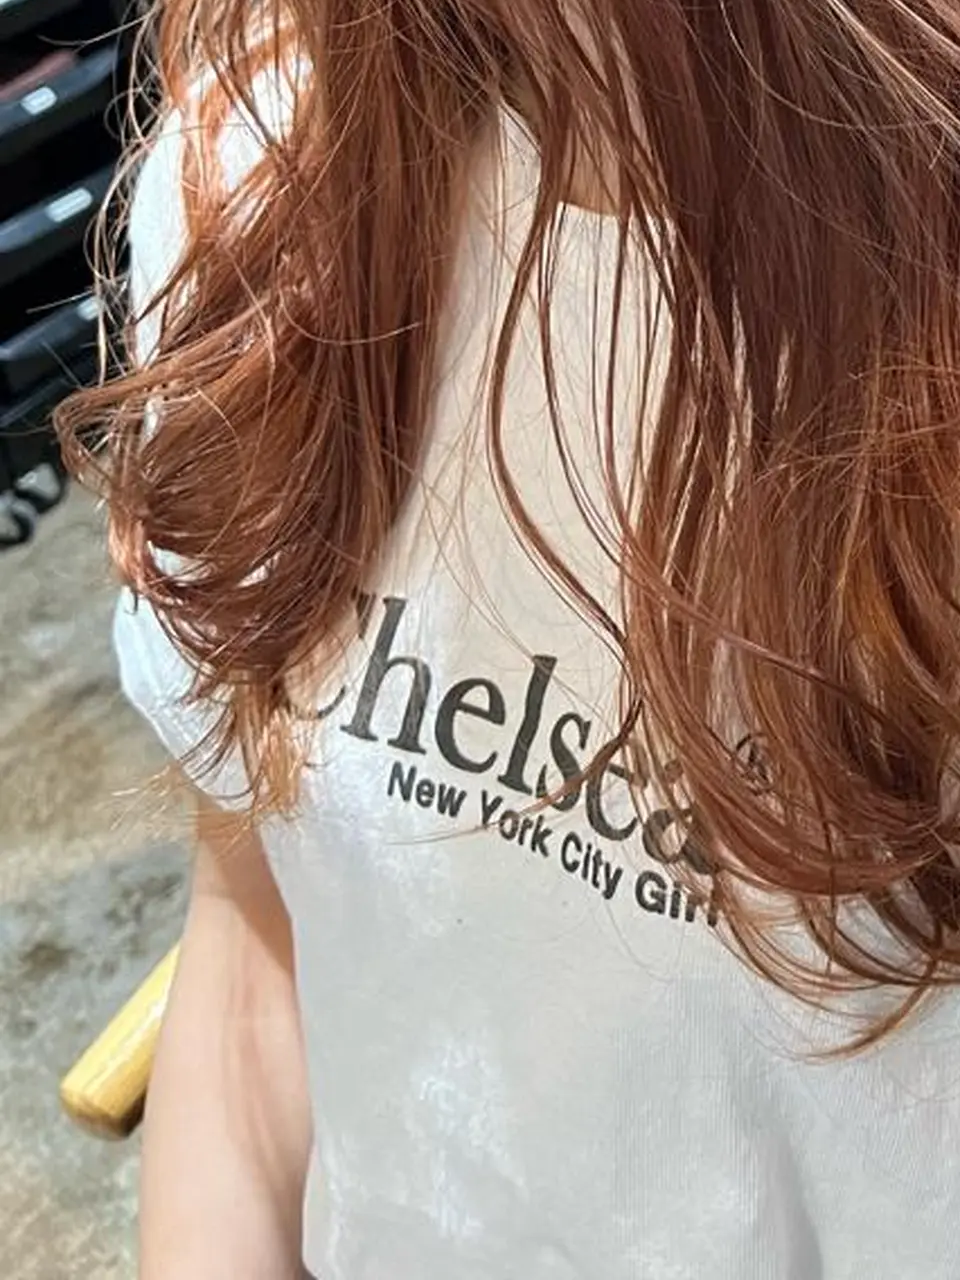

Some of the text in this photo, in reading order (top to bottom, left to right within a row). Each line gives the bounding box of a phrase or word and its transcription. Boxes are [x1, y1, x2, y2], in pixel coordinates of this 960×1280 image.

[316, 592, 721, 875] helsea
[387, 761, 467, 818] New
[481, 789, 552, 858] York
[560, 831, 623, 900] City
